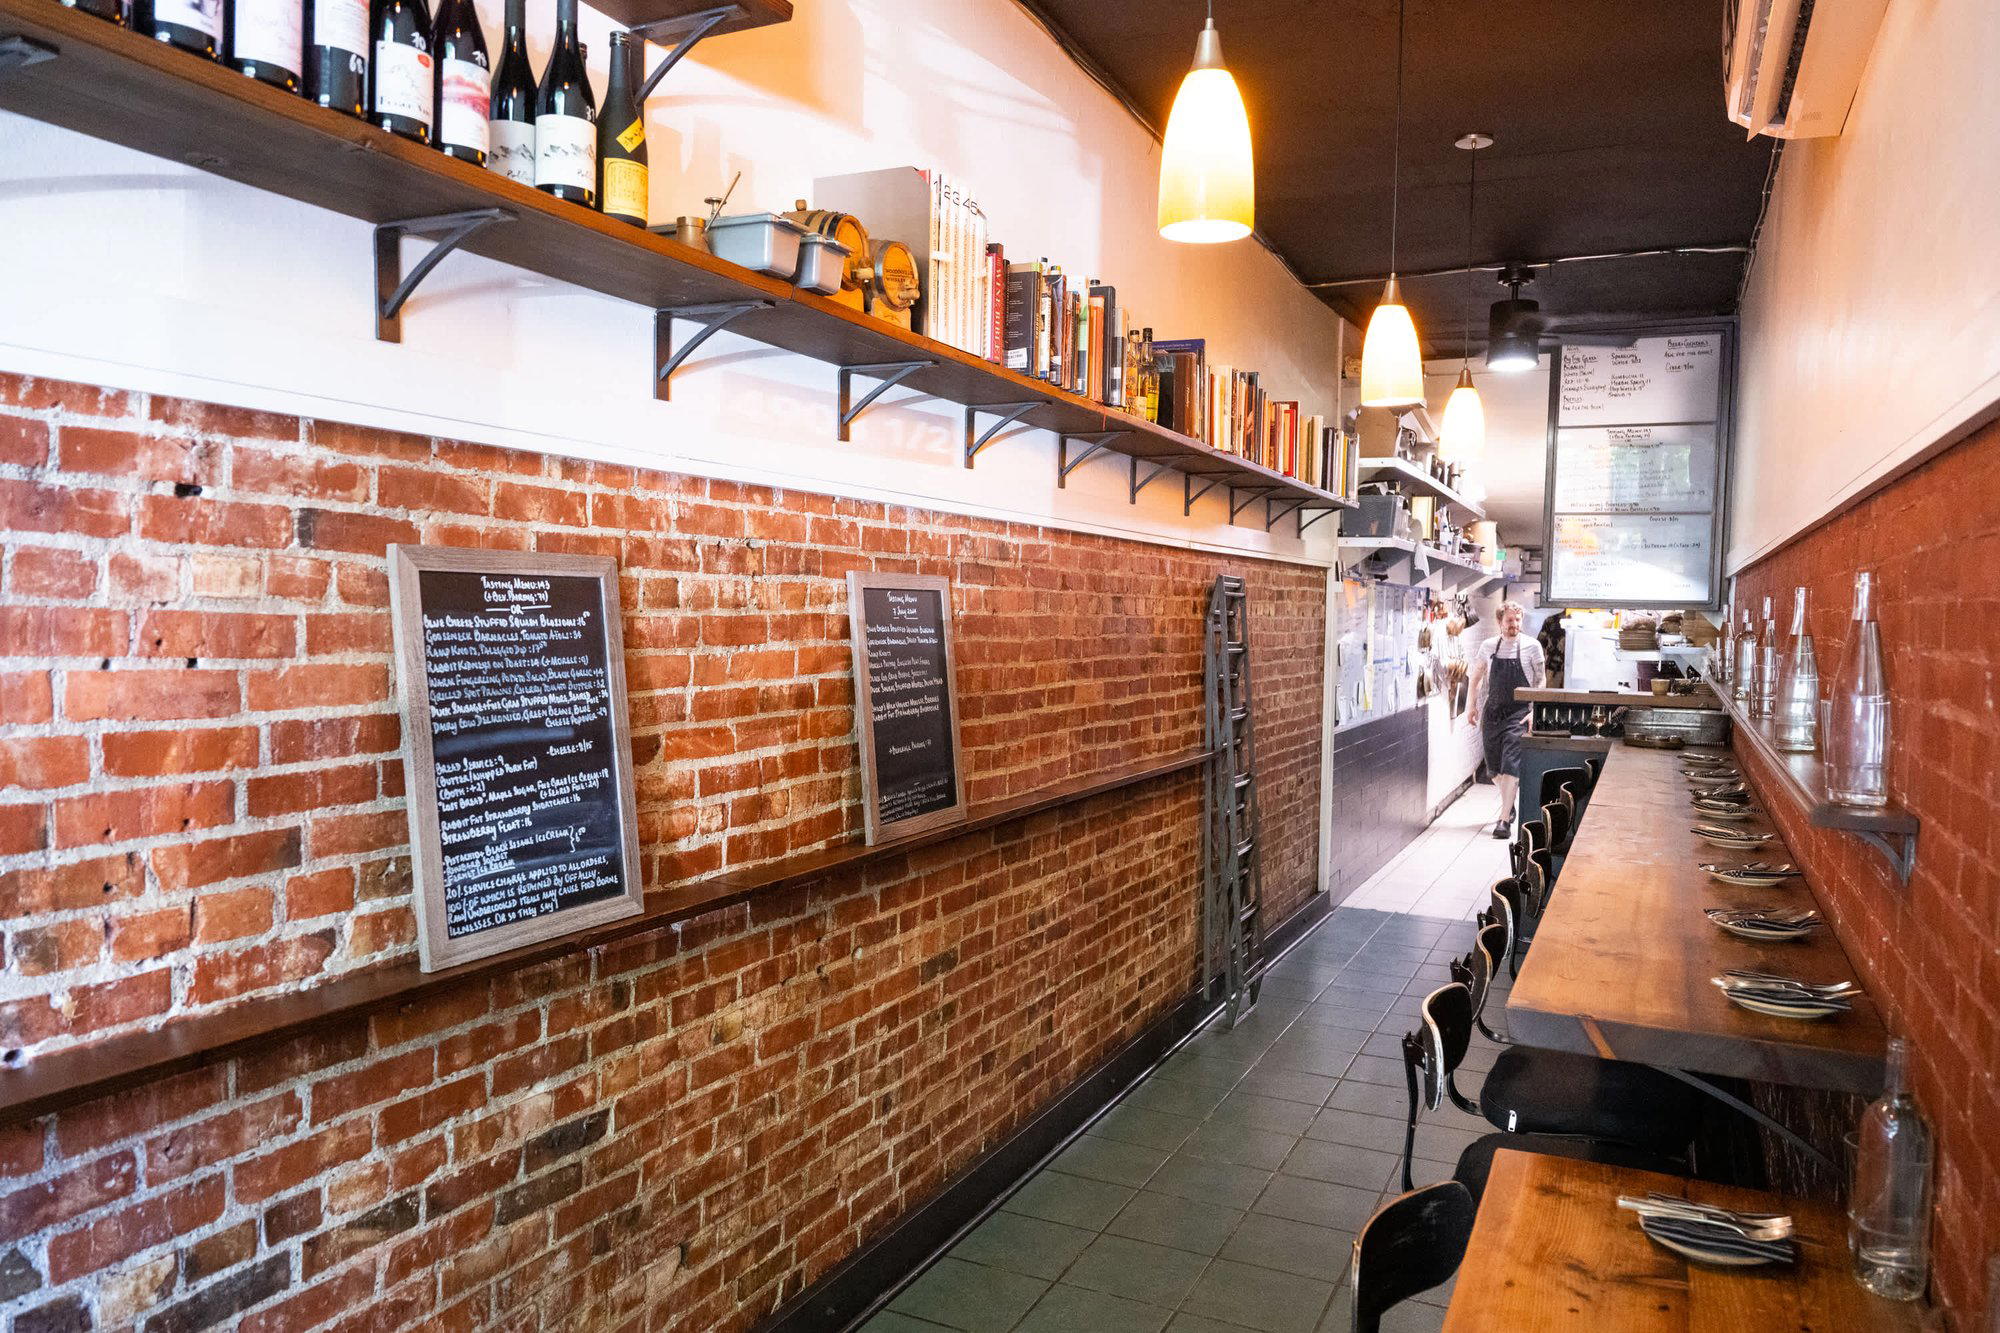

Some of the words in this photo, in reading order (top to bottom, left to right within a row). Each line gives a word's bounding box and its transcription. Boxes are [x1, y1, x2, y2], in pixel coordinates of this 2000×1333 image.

[481, 576, 513, 592] TASTING
[510, 604, 524, 615] OR
[423, 614, 445, 628] BLUE
[446, 614, 474, 628] CHEESE
[474, 615, 508, 628] STUFFED
[508, 615, 538, 628] SQUASH
[426, 629, 473, 645] GOOSENECK
[521, 629, 549, 640] TOMATO
[426, 644, 450, 659] RAMP
[427, 660, 457, 673] RABBIT
[457, 660, 491, 675] KIDNEYS
[492, 661, 504, 669] ON
[429, 676, 455, 688] WARM
[455, 673, 502, 688] FINGERLING
[501, 672, 526, 683] POTATO
[548, 667, 570, 679] BLACK
[430, 690, 462, 705] GRILLED
[463, 687, 480, 700] SPOT
[514, 683, 543, 695] CHERRY
[542, 682, 567, 692] TOMATO
[430, 705, 451, 718] DUCK
[520, 694, 549, 707] STUFFED
[432, 721, 457, 735] DAIRY
[458, 718, 477, 729] COW
[523, 709, 548, 724] GREEN
[573, 704, 591, 715] BLUE
[545, 717, 570, 728] CHEESE
[435, 762, 461, 776] BREAD
[504, 763, 523, 774] PORK
[488, 790, 513, 802] MAPLE
[537, 779, 550, 790] FOIE
[550, 776, 568, 789] GRAS
[568, 774, 579, 784] ICE
[441, 817, 469, 831] RABBIT
[469, 813, 483, 826] FAT
[484, 804, 531, 822] STRAWBERRY
[441, 825, 497, 845] STRAWBERRY
[484, 841, 508, 857] BLACK
[509, 836, 535, 850] SESAME
[546, 829, 570, 841] CREAM
[482, 851, 508, 865] SORBET
[489, 859, 516, 872] CREAM
[463, 881, 496, 897] SERVICE
[496, 872, 527, 886] CHARGE
[528, 864, 558, 880] APPLIED
[558, 863, 567, 873] TO
[467, 896, 479, 911] OF
[480, 890, 506, 904] WHICH
[507, 888, 515, 897] IS
[517, 877, 552, 895] RETAINED
[553, 875, 564, 887] BY
[564, 872, 578, 884] OFF
[519, 893, 541, 906] ITEMS
[542, 889, 558, 908] MAY
[558, 884, 580, 897] CAUSE
[581, 880, 596, 892] FOOD
[596, 874, 619, 887] BORNE
[495, 912, 507, 925] OR
[507, 911, 517, 921] SO
[517, 906, 538, 918] THEY
[540, 901, 554, 913] SAY
